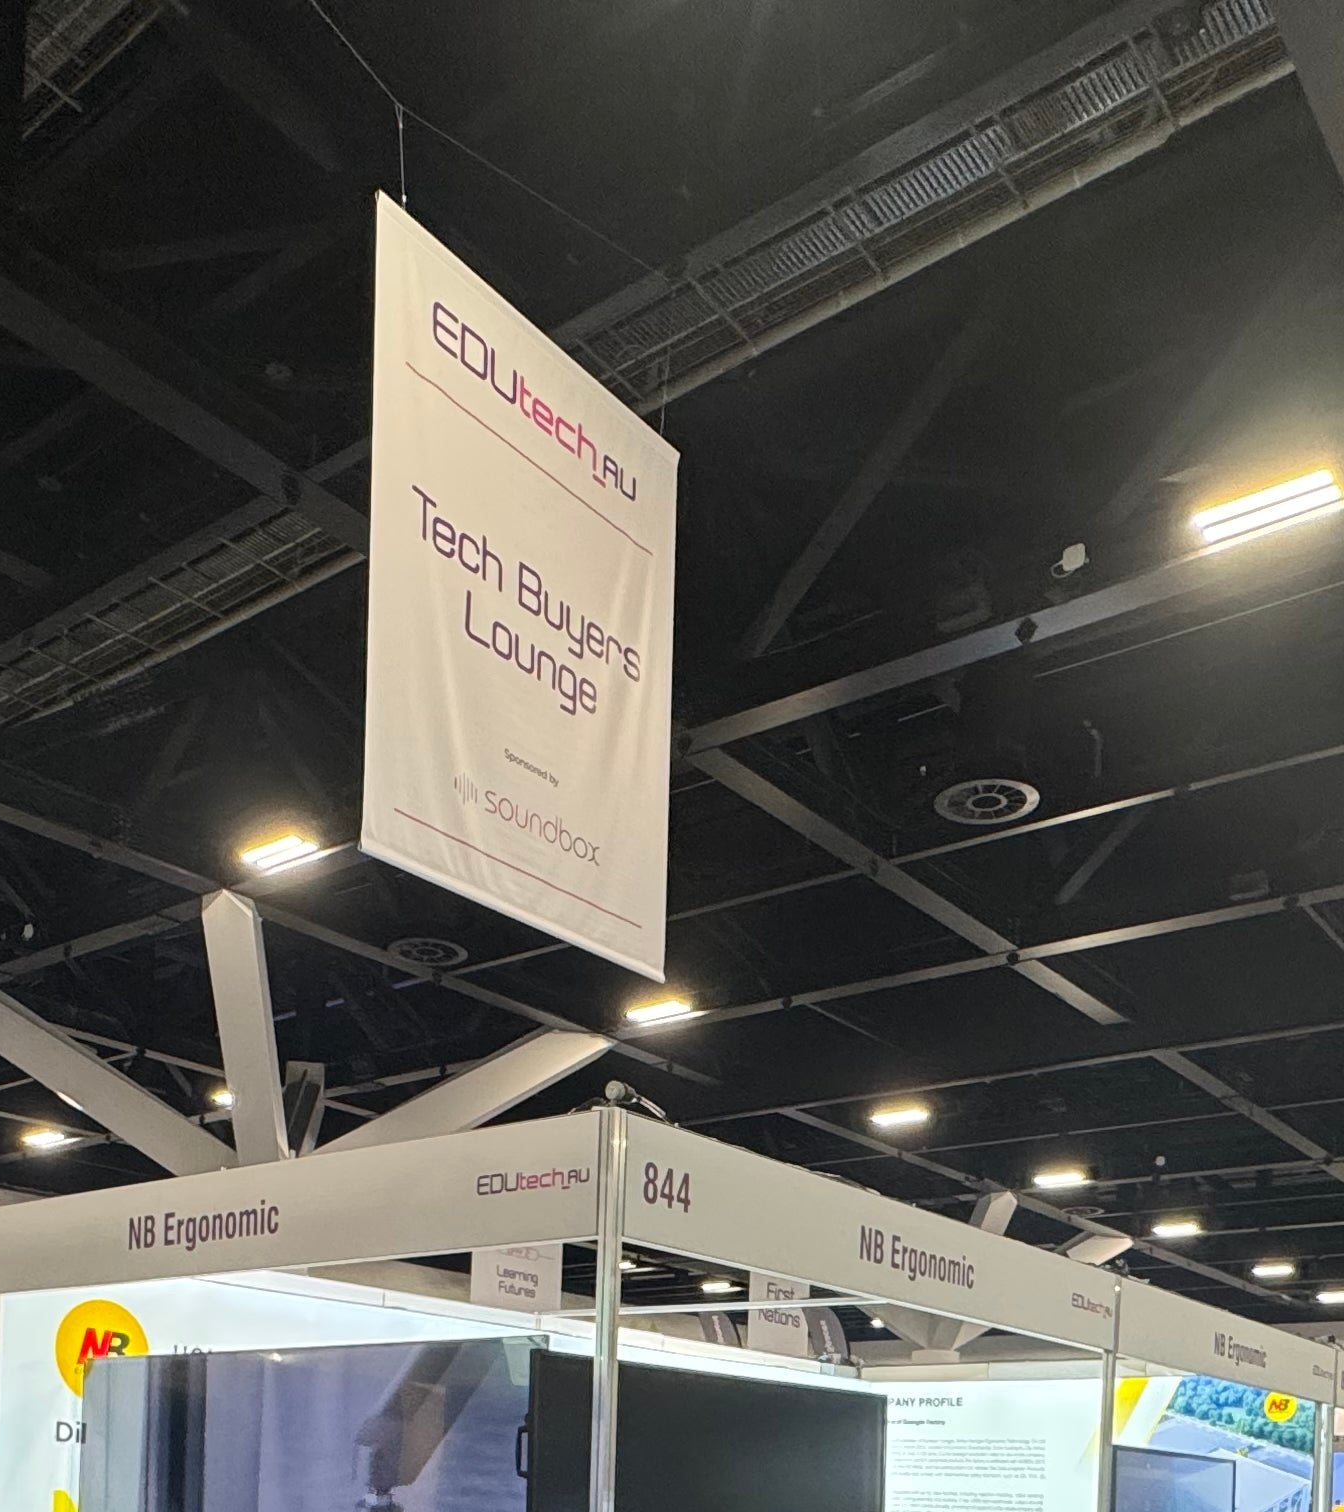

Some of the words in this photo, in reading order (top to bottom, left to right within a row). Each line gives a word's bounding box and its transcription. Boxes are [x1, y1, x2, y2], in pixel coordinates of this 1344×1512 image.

[412, 484, 503, 593] Tech
[518, 560, 641, 683] Buyers
[464, 590, 598, 717] Lounge
[504, 748, 548, 780] Sponsored
[549, 773, 559, 788] by
[484, 790, 601, 867] soundbox
[642, 1161, 691, 1213] 844
[128, 1214, 156, 1251] NB
[163, 1200, 280, 1252] Ergonomic
[496, 1264, 538, 1288] Learning
[859, 1224, 884, 1265] NB
[891, 1234, 975, 1289] Ergonomic
[497, 1280, 536, 1299] Futures
[766, 1281, 795, 1301] First
[757, 1308, 801, 1329] Nations
[1214, 1331, 1226, 1357] NB
[1227, 1335, 1268, 1369] Ergonomic
[918, 1396, 964, 1408] PROFILE
